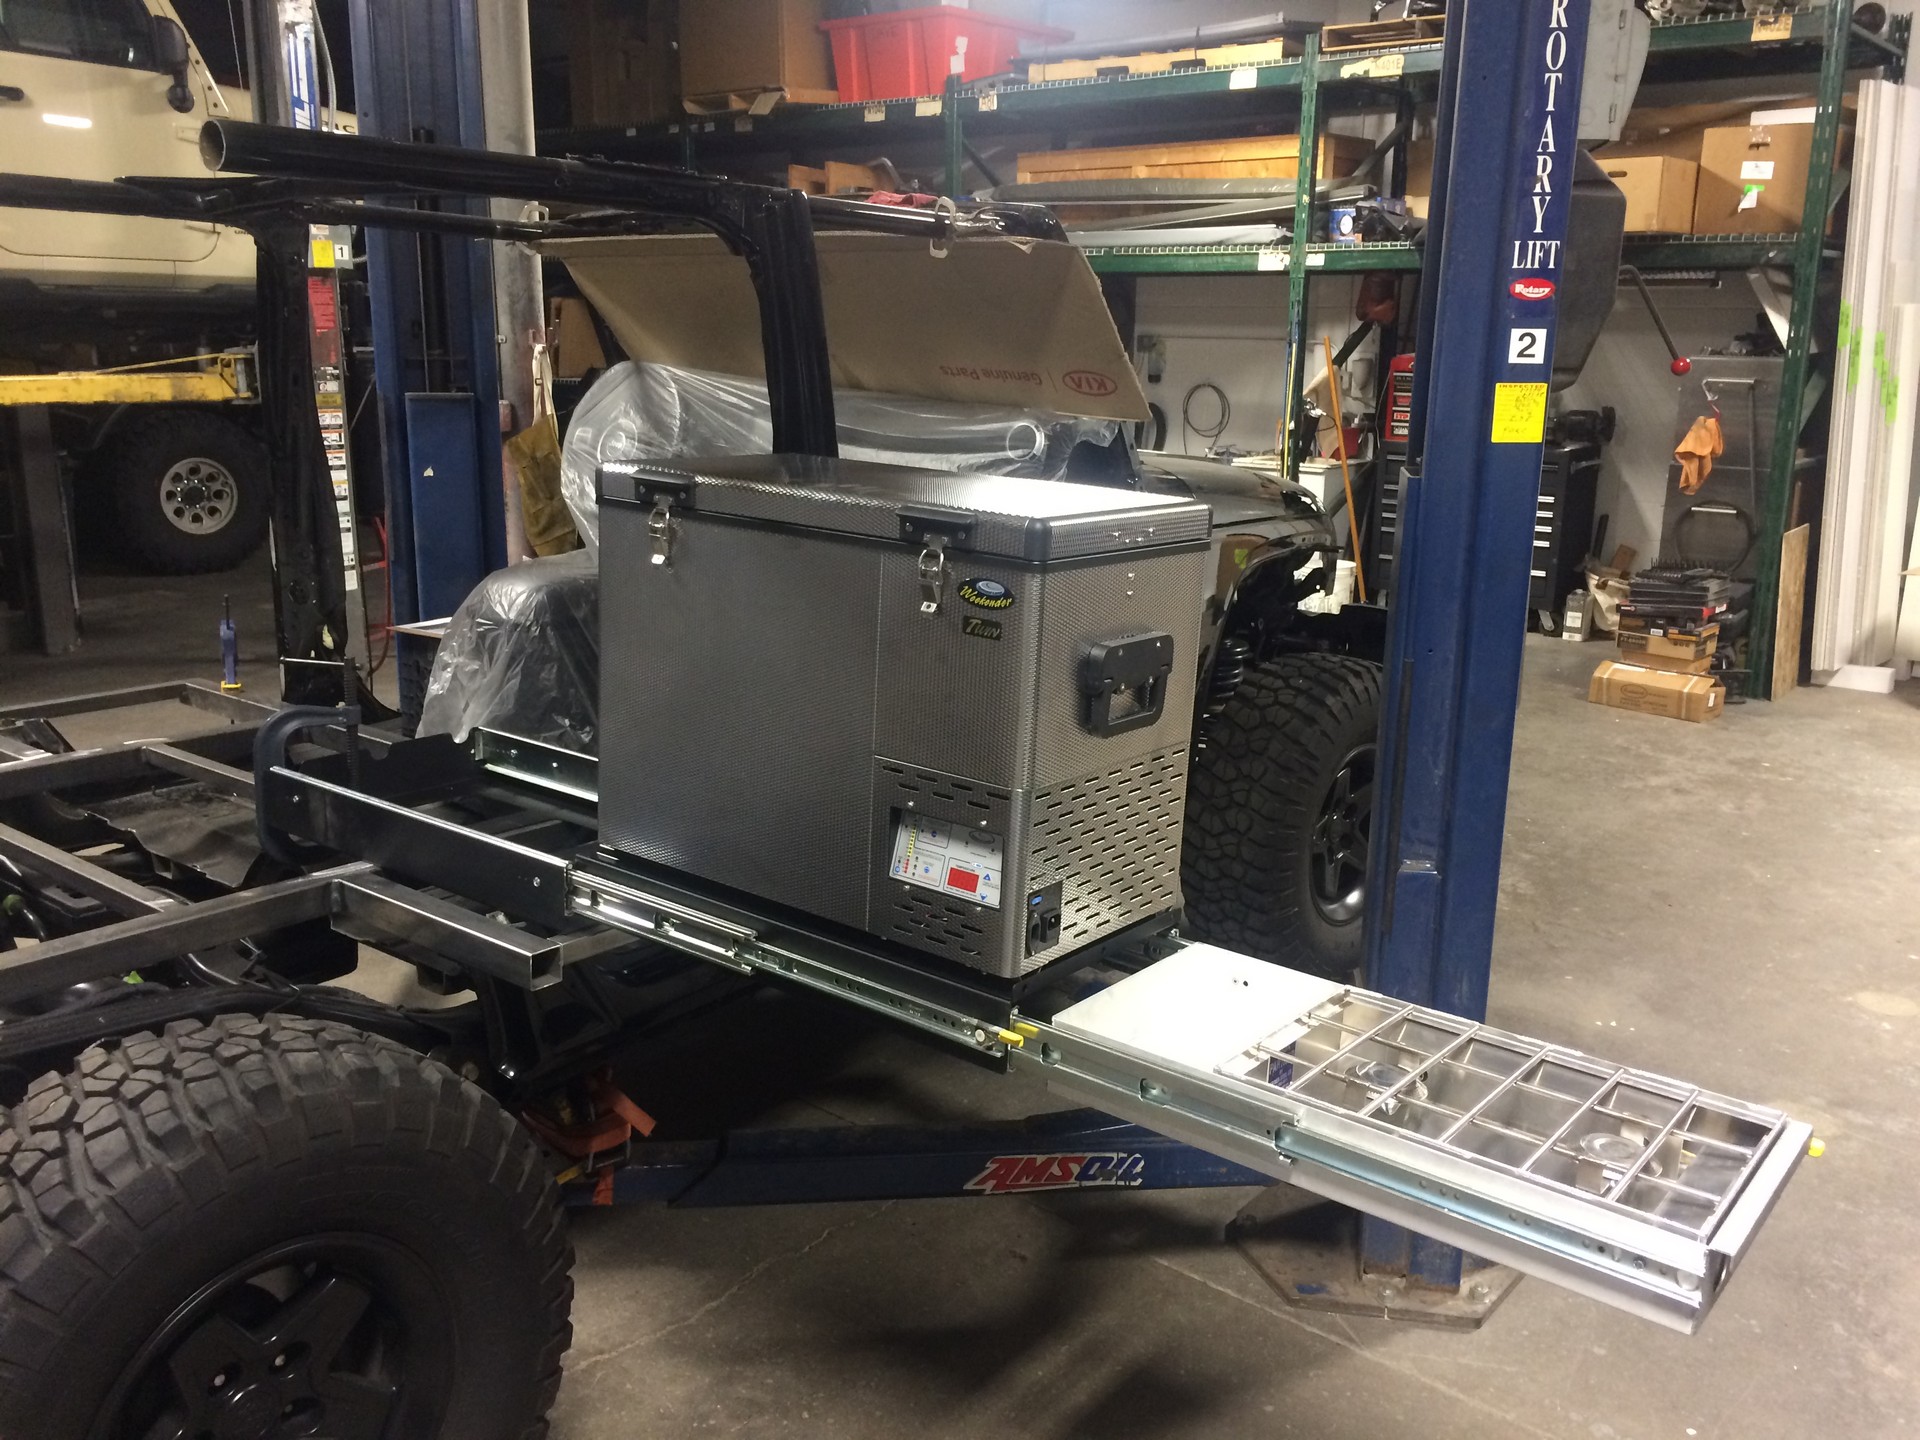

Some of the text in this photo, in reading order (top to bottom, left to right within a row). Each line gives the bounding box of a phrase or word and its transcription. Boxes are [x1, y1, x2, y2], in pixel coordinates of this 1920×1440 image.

[1532, 0, 1568, 233] ROTARY
[1511, 240, 1560, 268] LIFT
[1514, 283, 1551, 298] Rotary
[1516, 331, 1537, 358] 2
[939, 365, 1109, 391] KIA Genuine Parts
[959, 585, 1013, 608] Weekender
[968, 1154, 1145, 1193] AMSOIL
